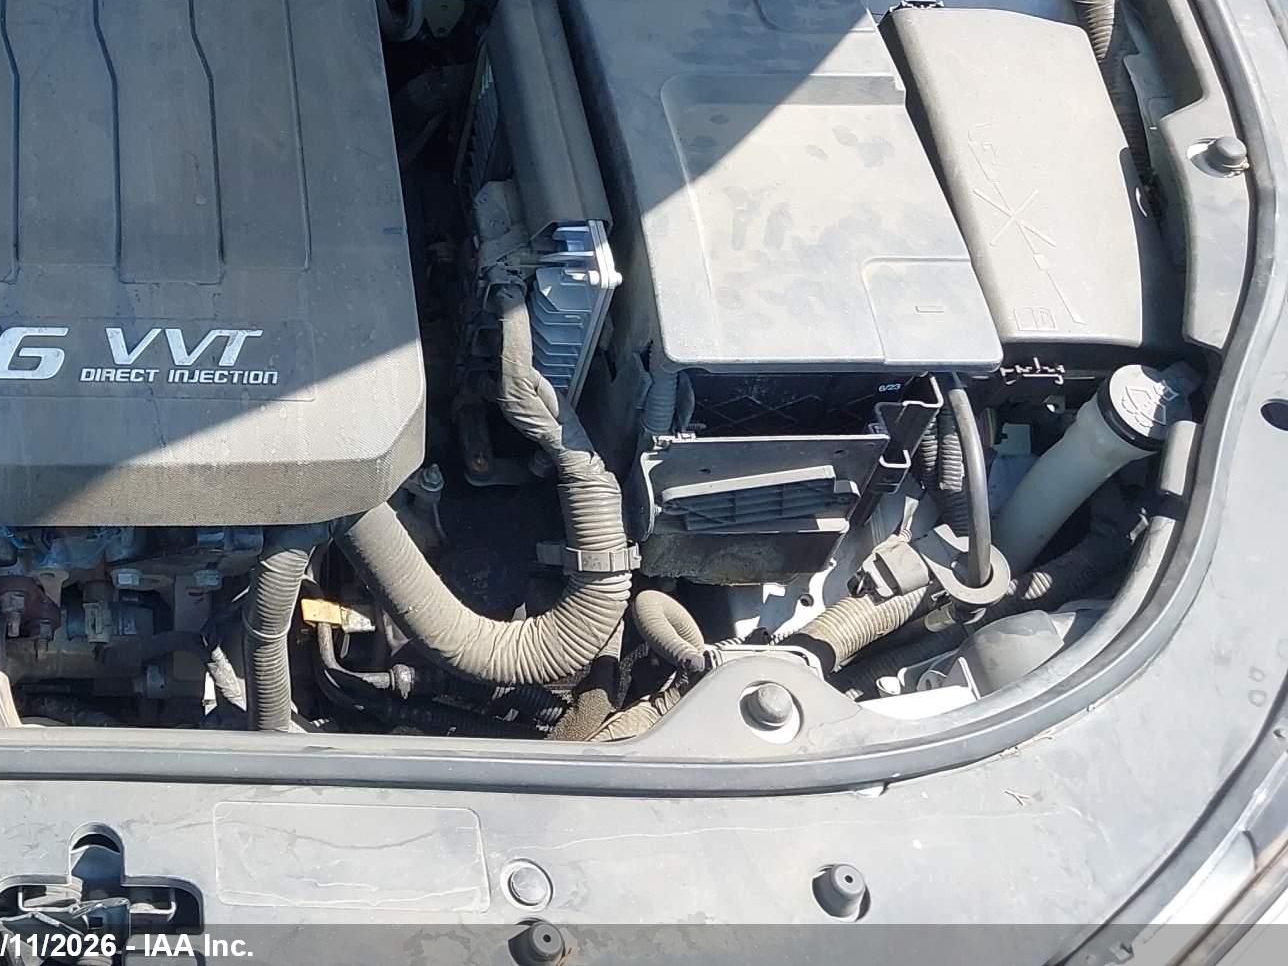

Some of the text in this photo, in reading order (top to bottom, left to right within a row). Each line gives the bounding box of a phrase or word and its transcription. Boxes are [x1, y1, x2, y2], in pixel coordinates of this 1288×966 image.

[105, 327, 264, 367] VVT
[79, 368, 279, 385] DIRECT INJECTION
